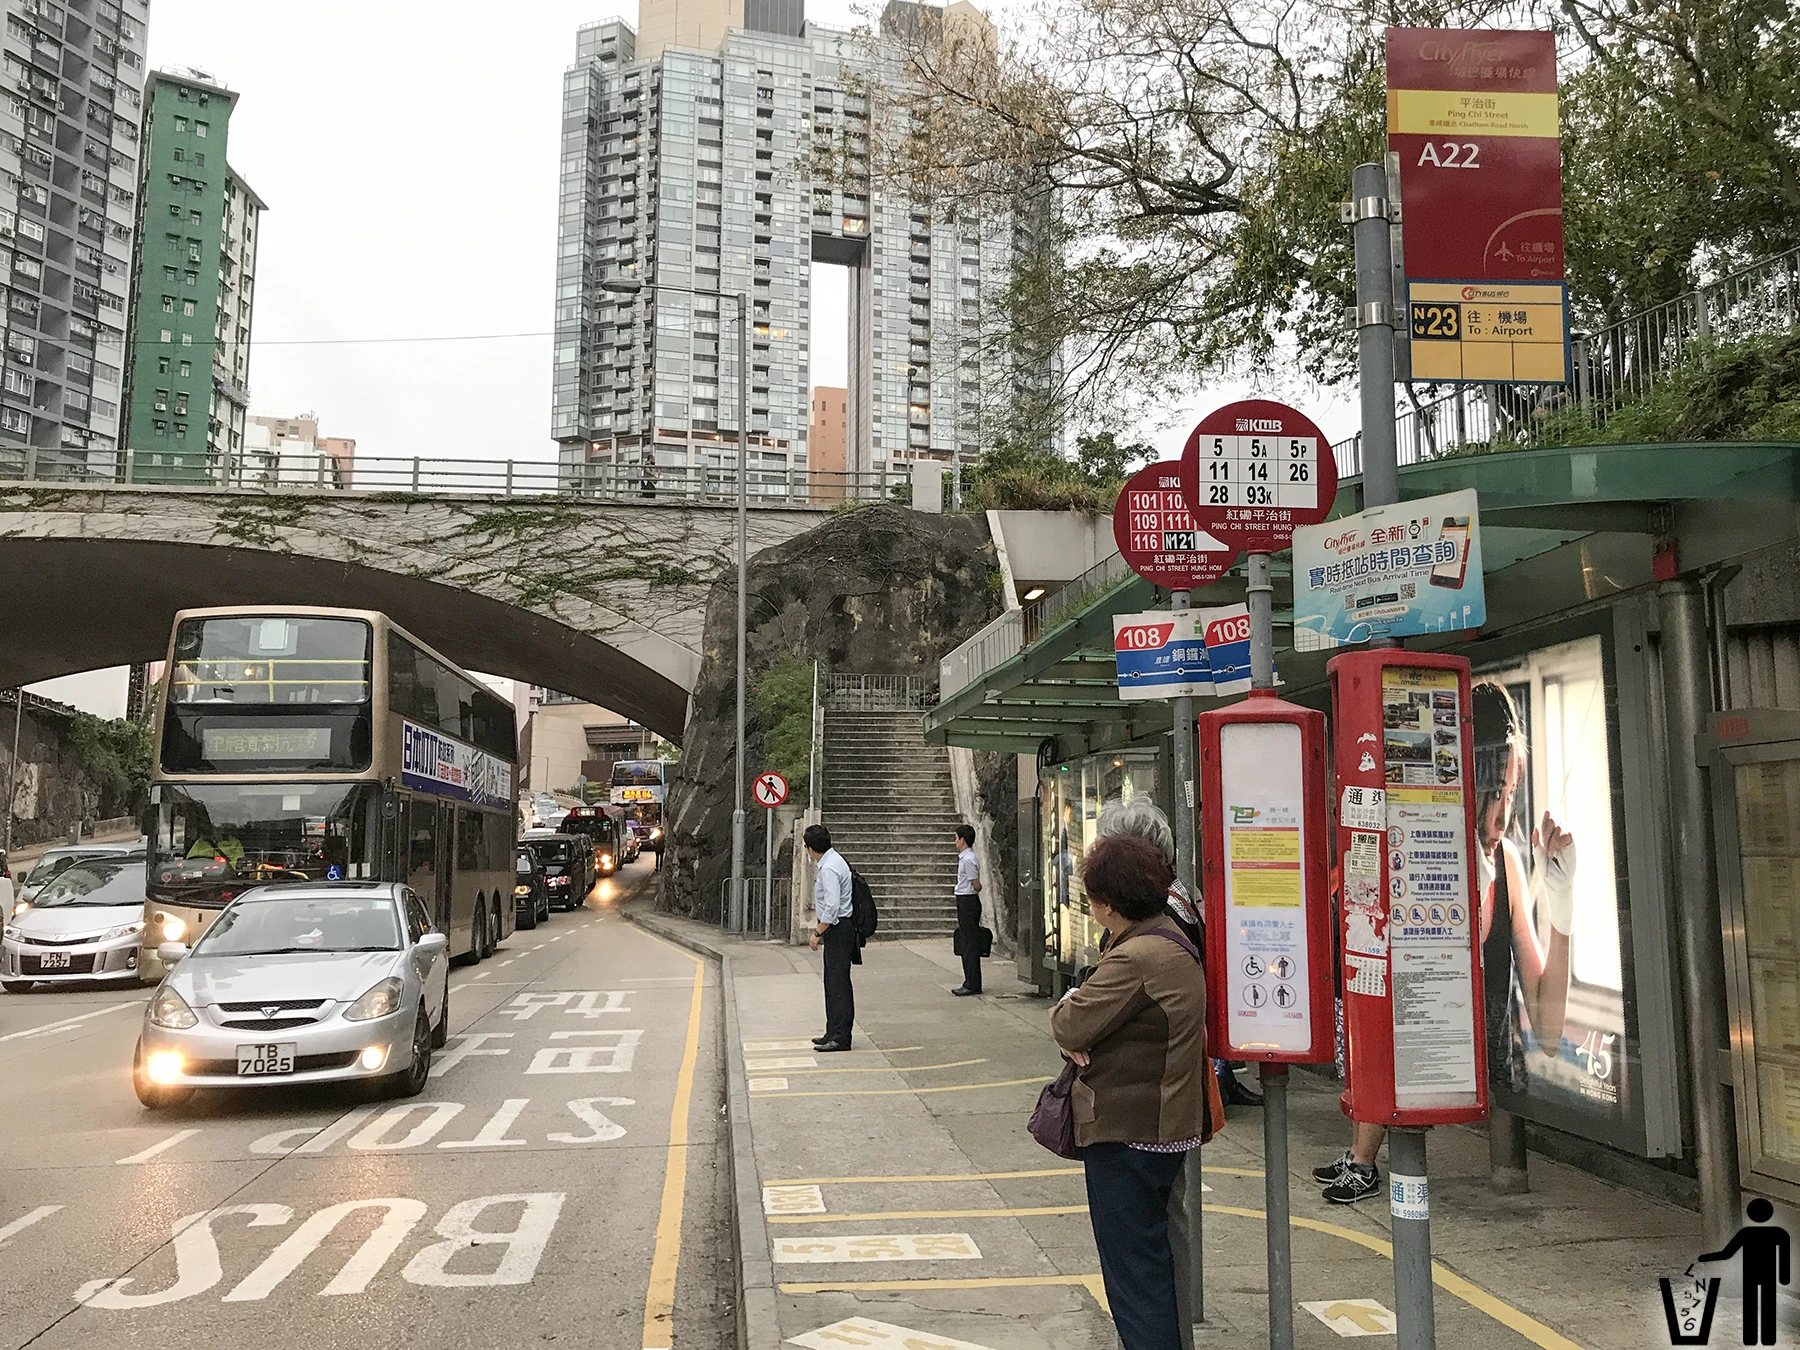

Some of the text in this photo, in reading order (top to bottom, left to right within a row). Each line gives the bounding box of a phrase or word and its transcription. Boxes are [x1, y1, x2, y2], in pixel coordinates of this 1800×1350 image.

[1460, 97, 1496, 109] 平治街
[1448, 110, 1508, 119] Ping Chi Street
[1417, 142, 1480, 169] A22
[1520, 241, 1555, 253] 往機場
[1515, 254, 1556, 264] To Airport
[1467, 290, 1496, 298] CITYBUS
[1467, 325, 1481, 335] To
[1491, 325, 1533, 338] Airport
[1249, 419, 1283, 432] KMB
[1213, 438, 1307, 458] 5 5A 5P
[1209, 461, 1309, 481] 11 14 26
[1133, 493, 1157, 509] 101
[1209, 485, 1272, 504] 28 93K
[1134, 513, 1190, 530] 109 111
[1226, 508, 1292, 522] 紅磡平治街
[1211, 522, 1227, 530] PING
[1244, 523, 1270, 531] STREET
[1272, 523, 1292, 531] HUNG
[1370, 525, 1404, 544] 全新
[1134, 533, 1195, 549] 116 N121
[1153, 554, 1208, 564] 紅磡平治街
[1309, 540, 1455, 588] 實時抵站時間查詢
[1329, 582, 1353, 594] Real-time
[1353, 578, 1368, 587] Next
[1382, 571, 1408, 581] Arrival
[1409, 569, 1430, 577] Time
[1123, 627, 1161, 648] 108
[1212, 618, 1250, 643] 108
[50, 952, 63, 960] FN
[254, 1046, 278, 1058] TB
[1576, 1031, 1615, 1079] 45
[241, 1058, 291, 1074] 7025
[1603, 1081, 1616, 1092] Years
[1586, 1088, 1601, 1099] HONG
[1602, 1094, 1617, 1103] KONG
[249, 1097, 635, 1154] STOP
[1391, 1181, 1405, 1203] 通
[73, 1192, 567, 1308] BUS
